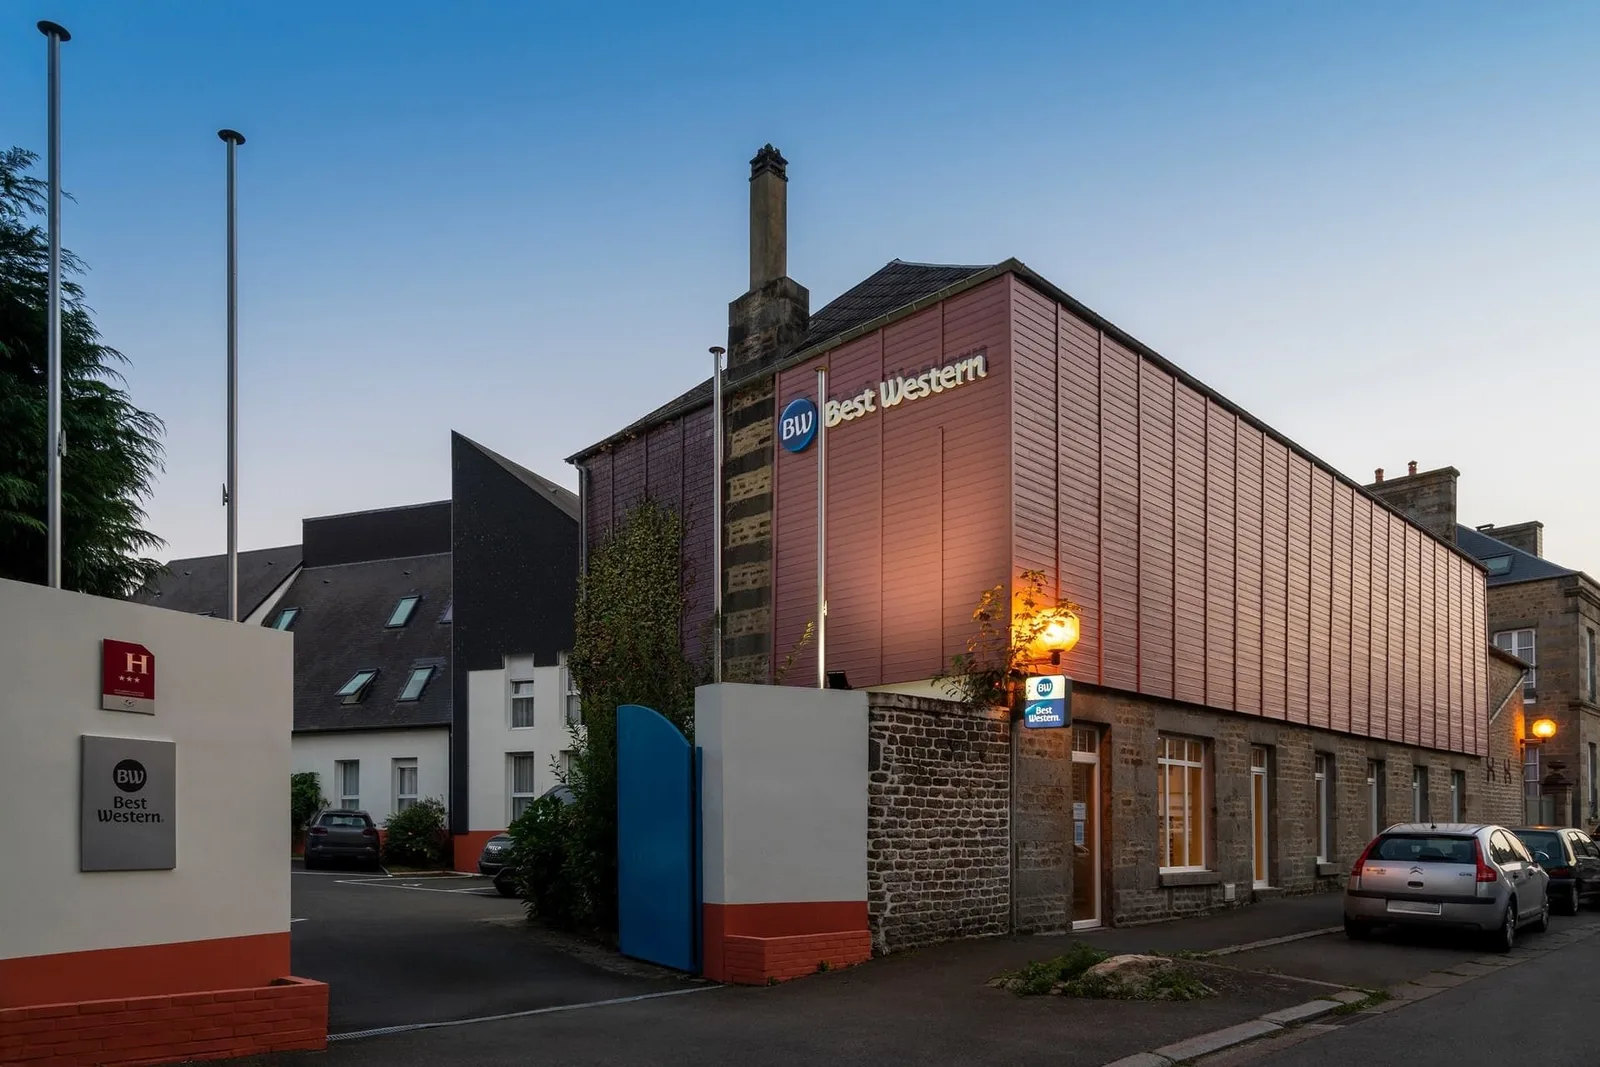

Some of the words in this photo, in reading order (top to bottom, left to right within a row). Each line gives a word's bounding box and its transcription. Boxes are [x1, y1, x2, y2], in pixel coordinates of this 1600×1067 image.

[824, 388, 877, 428] Best
[879, 354, 988, 409] Western
[782, 410, 813, 441] BW
[124, 652, 150, 675] H
[1038, 683, 1052, 692] BW
[1035, 706, 1053, 715] Best
[116, 768, 144, 786] BW
[113, 796, 148, 810] Best
